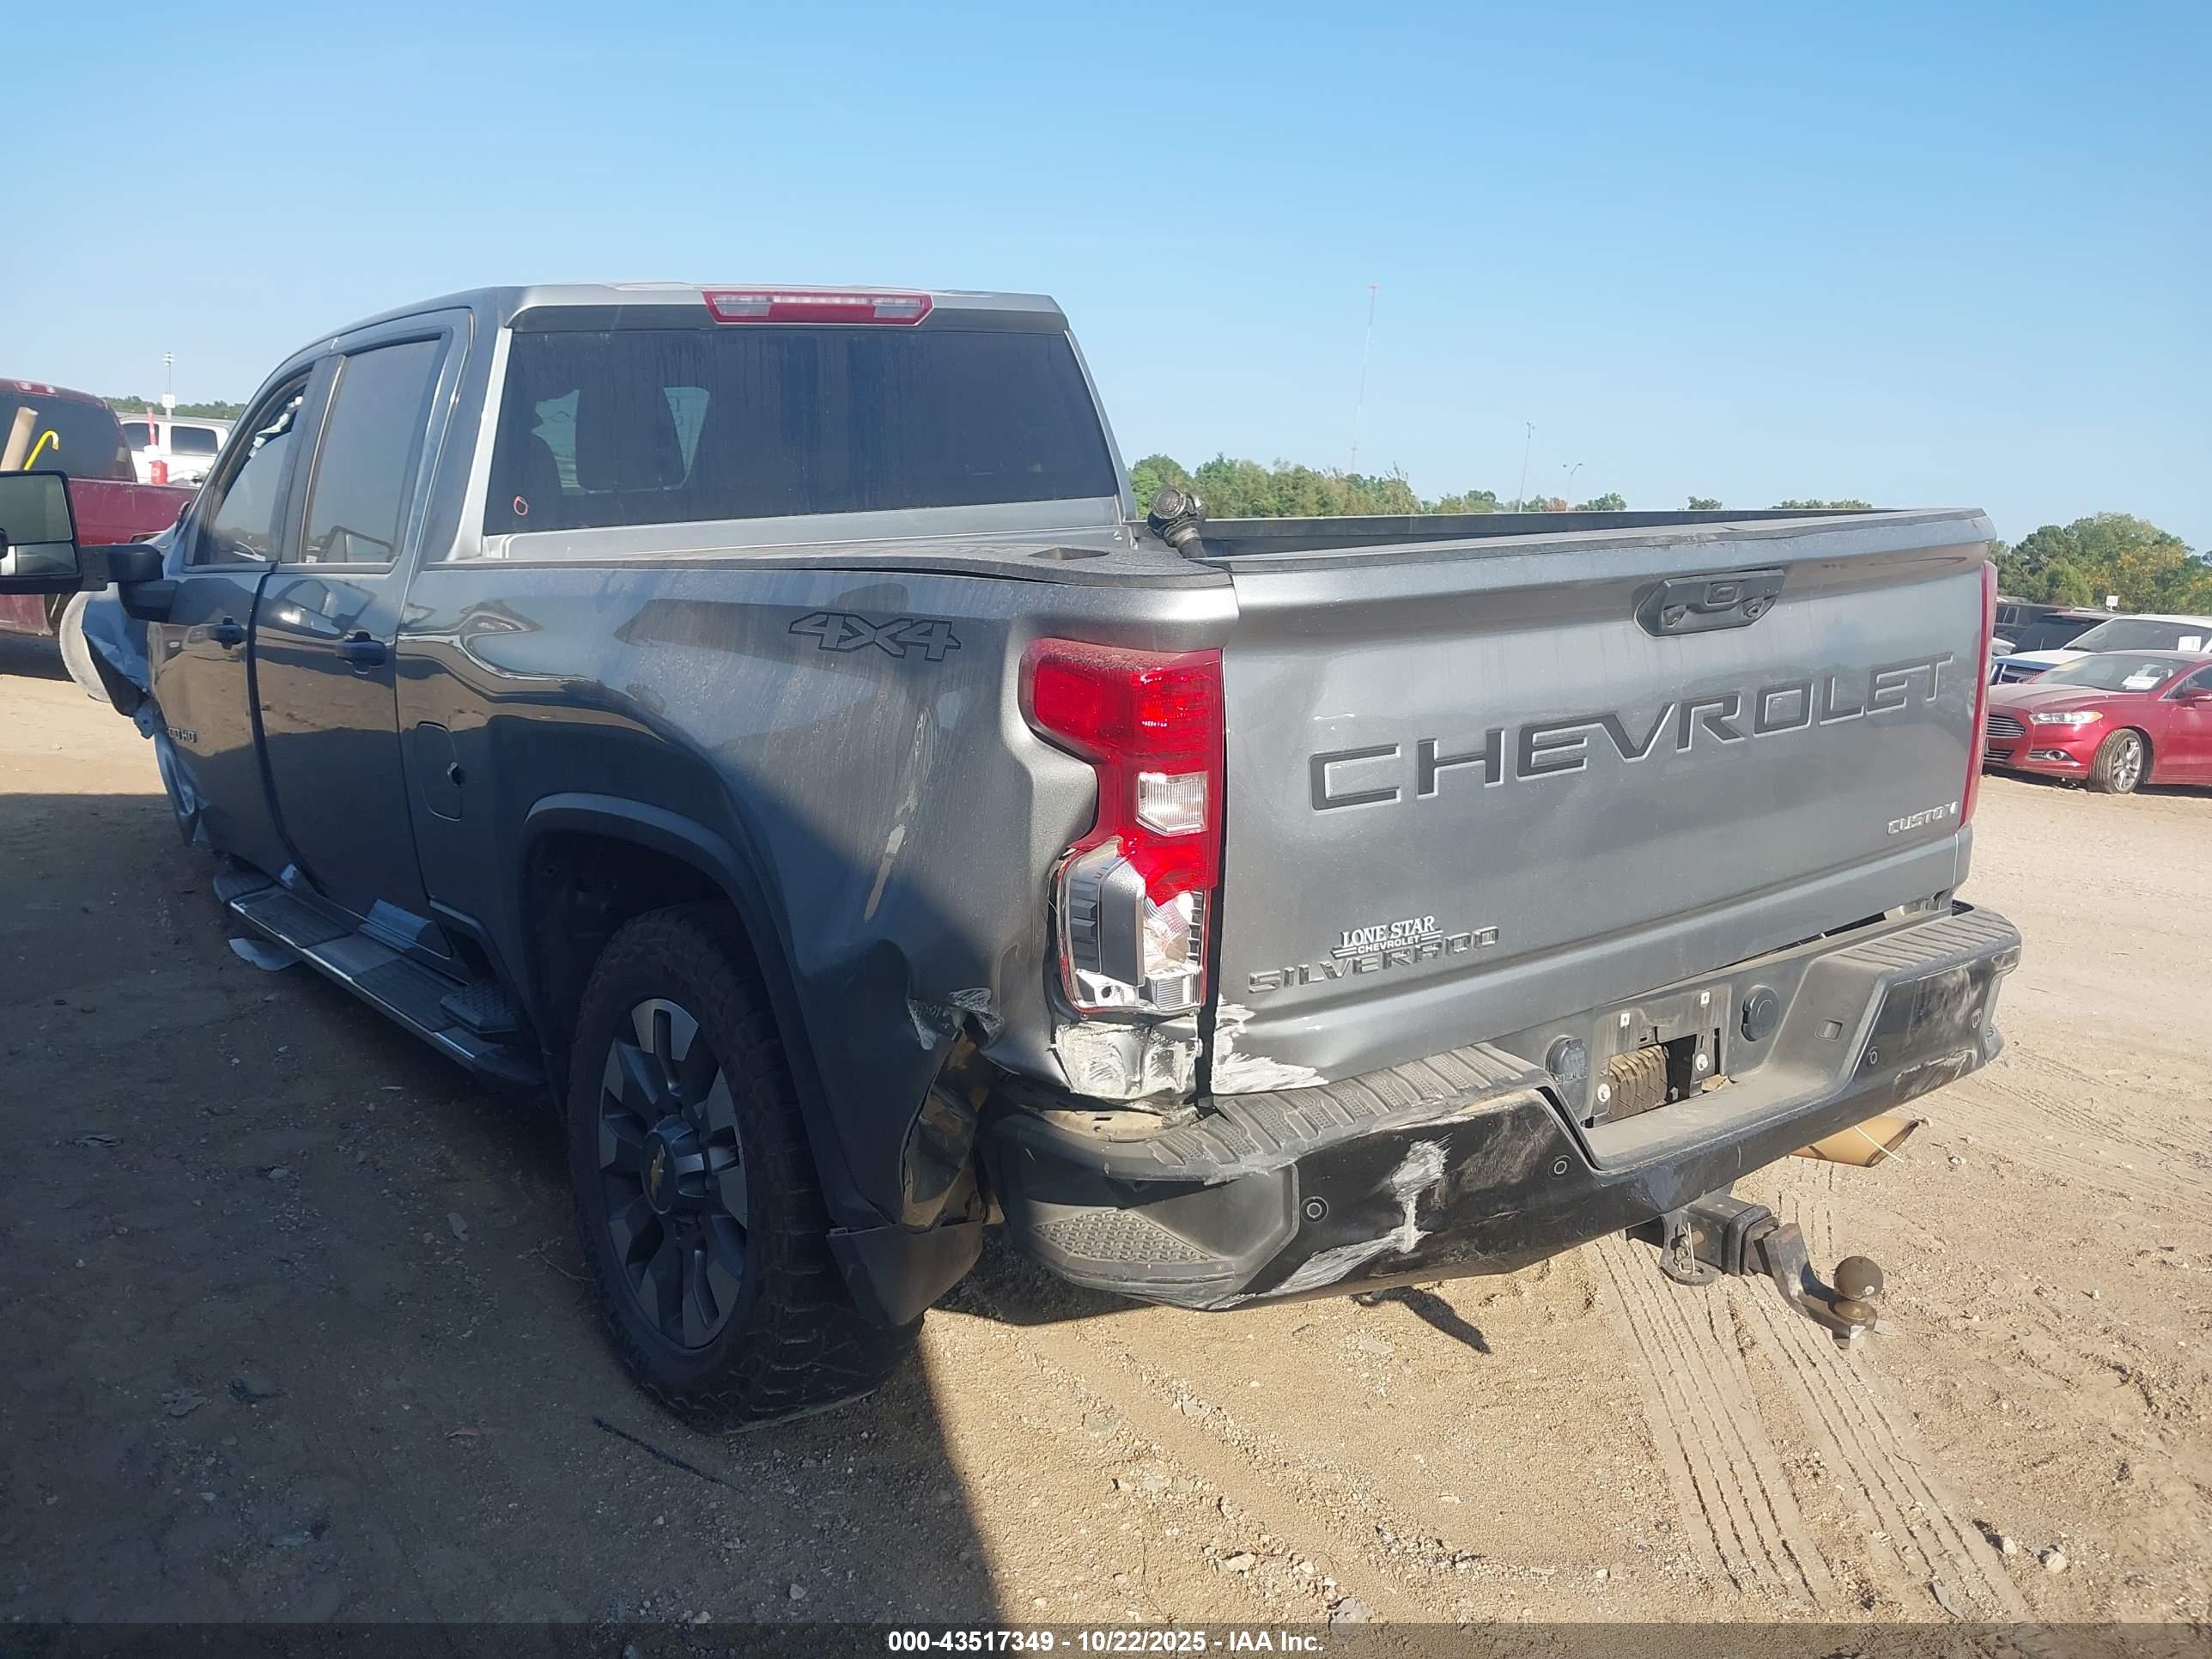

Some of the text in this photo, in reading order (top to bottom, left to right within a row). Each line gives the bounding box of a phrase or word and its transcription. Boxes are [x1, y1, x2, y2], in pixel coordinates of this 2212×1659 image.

[1310, 653, 1954, 812] CHEVROLET
[1340, 915, 1436, 949] LONE STAR
[1356, 934, 1421, 955] CHEVROLET
